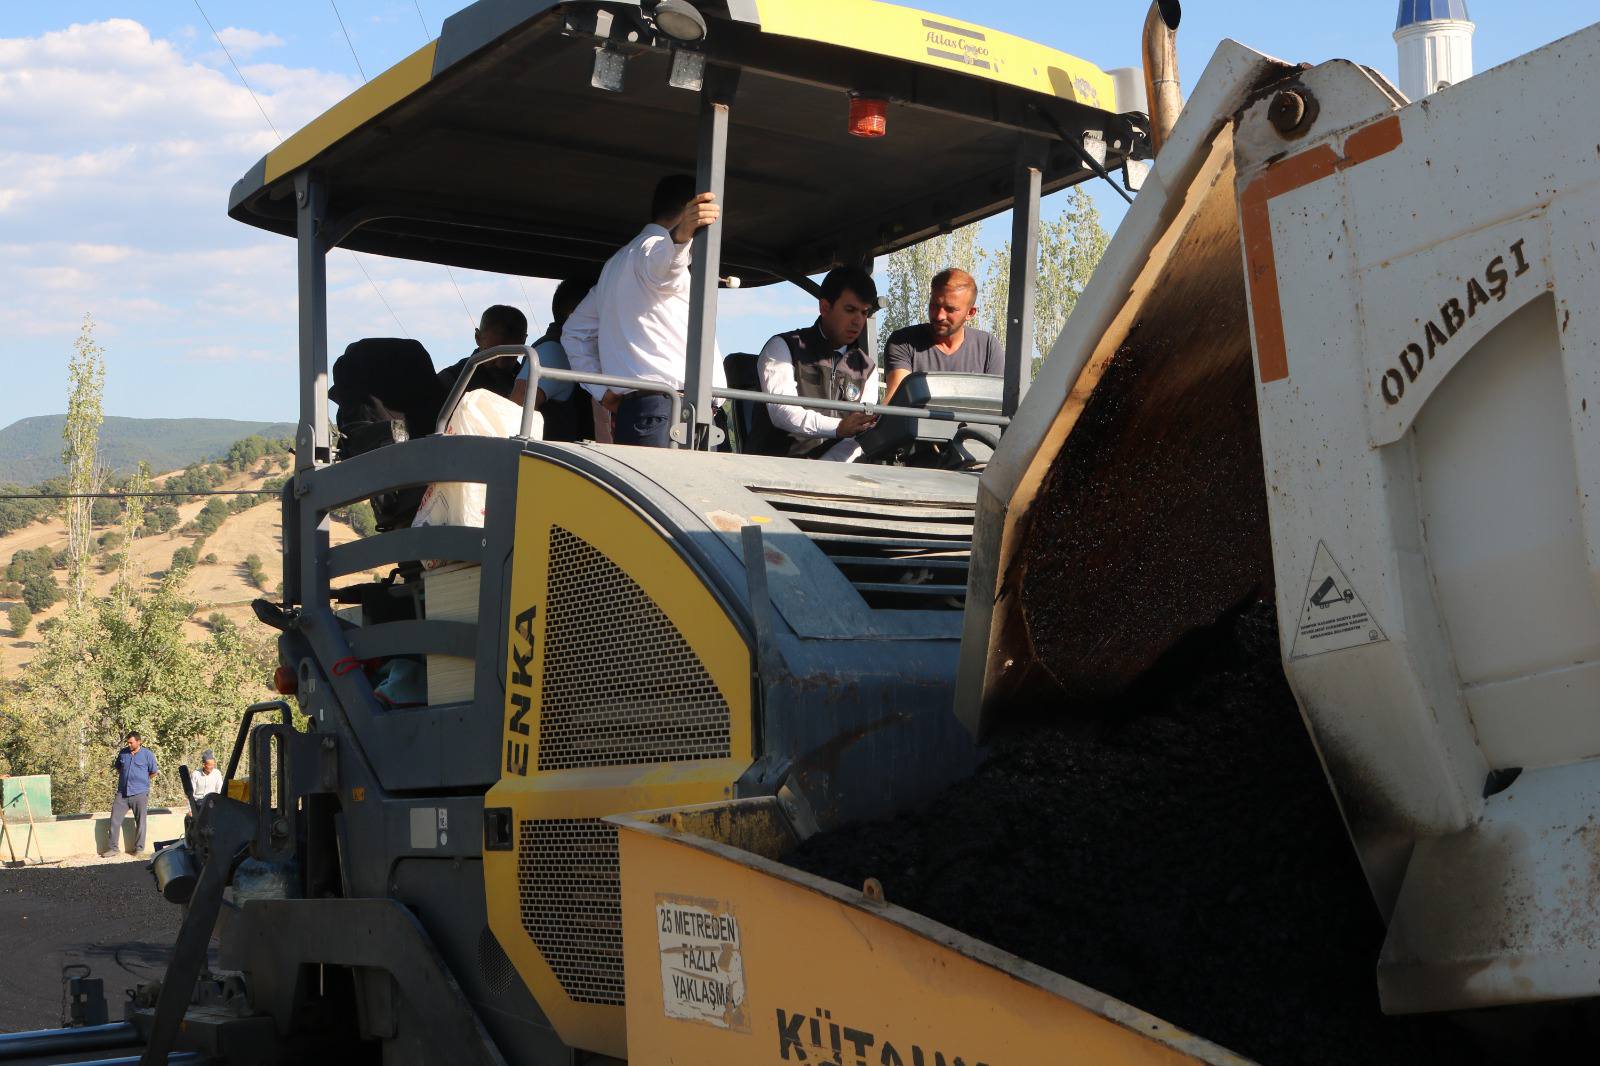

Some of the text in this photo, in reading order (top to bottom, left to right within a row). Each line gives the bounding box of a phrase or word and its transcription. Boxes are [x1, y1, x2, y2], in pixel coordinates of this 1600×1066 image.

[925, 31, 957, 49] Atlas
[1380, 238, 1531, 406] ODABAŞI
[506, 605, 537, 777] ENKA
[660, 908, 736, 943] 25 METREDEN
[681, 943, 719, 973] FAZLA
